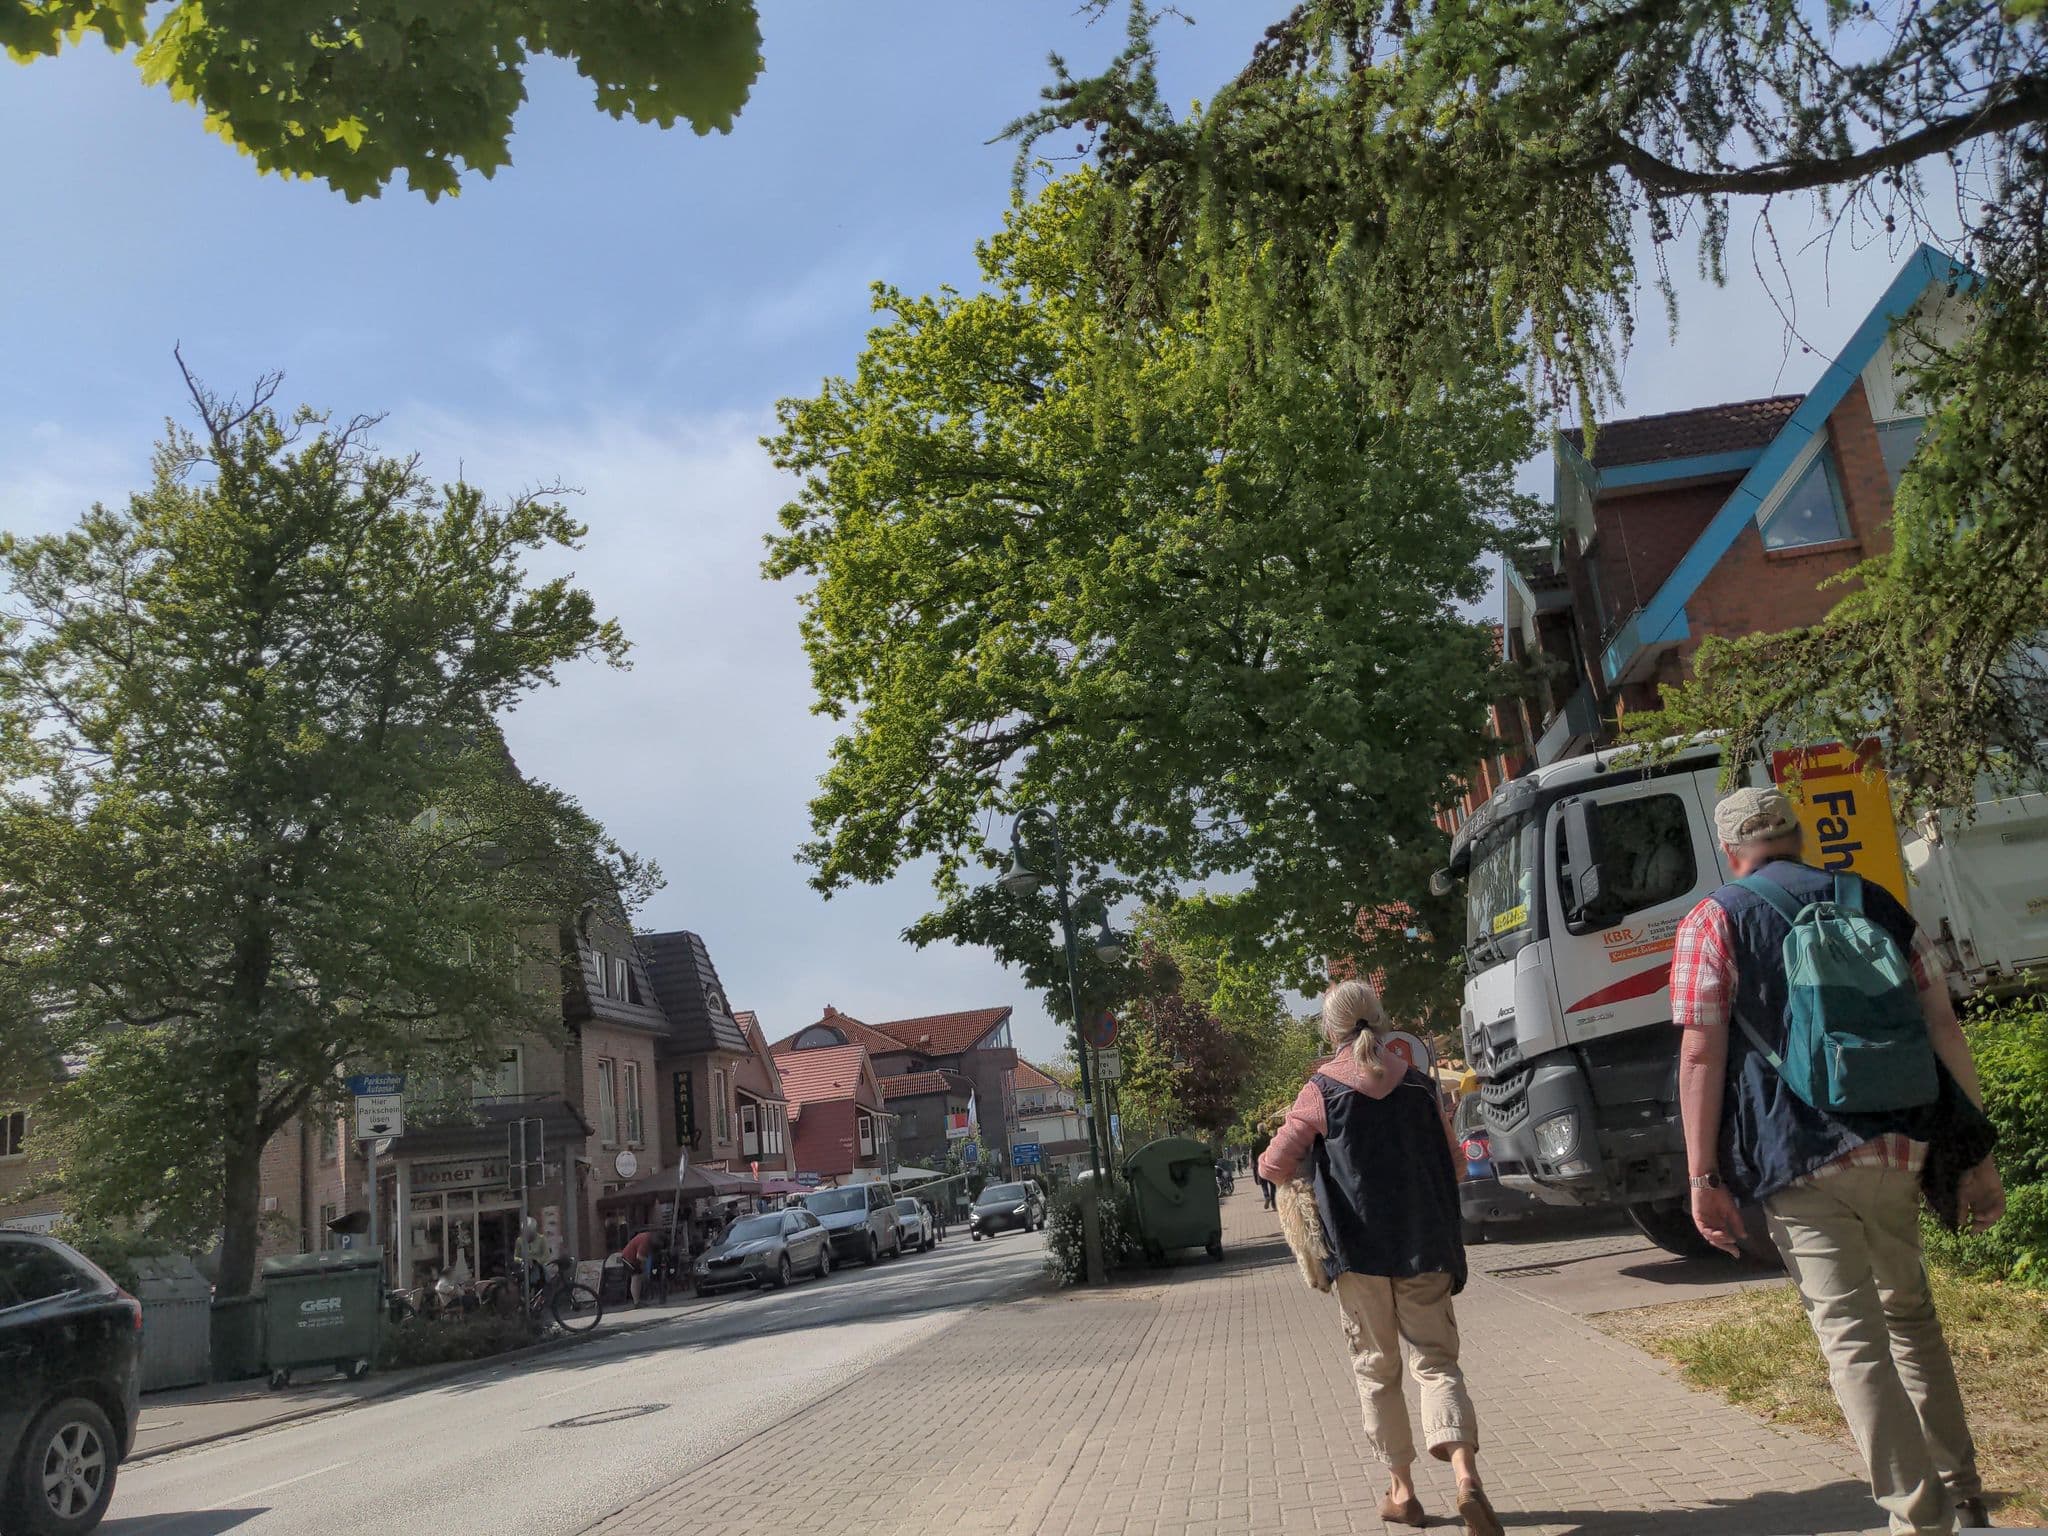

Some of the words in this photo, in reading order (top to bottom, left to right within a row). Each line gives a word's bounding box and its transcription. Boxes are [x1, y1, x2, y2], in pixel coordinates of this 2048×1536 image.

[1603, 929, 1633, 944] KBR
[364, 1076, 401, 1086] Parkschein
[360, 1106, 400, 1115] Parkschein
[370, 1115, 390, 1123] lösen
[342, 1235, 350, 1249] P
